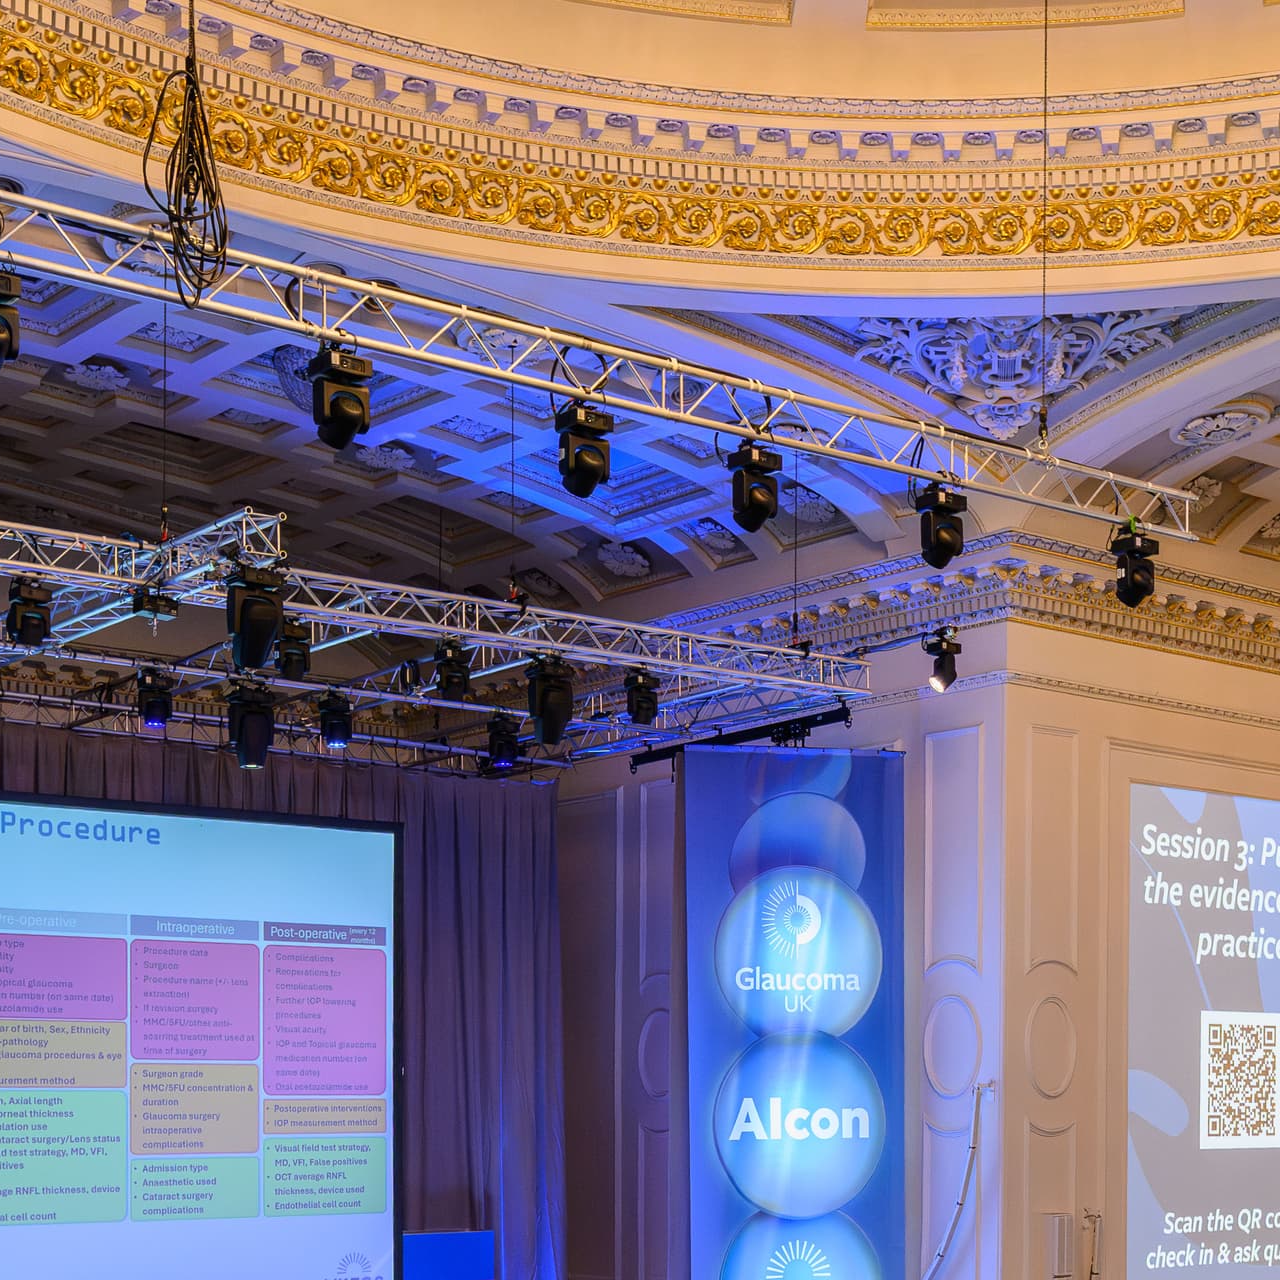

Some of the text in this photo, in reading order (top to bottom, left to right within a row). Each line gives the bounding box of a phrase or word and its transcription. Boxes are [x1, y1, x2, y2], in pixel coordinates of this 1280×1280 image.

[1, 811, 162, 845] Procedure
[1141, 824, 1229, 862] Session
[1234, 840, 1255, 871] 3:
[1144, 872, 1183, 905] the
[157, 919, 235, 936] Intraoperative
[270, 926, 347, 941] Post-operative
[735, 967, 860, 992] Glaucoma
[784, 995, 812, 1013] UK
[729, 1096, 870, 1141] Alcon
[1164, 1212, 1203, 1234] Scan
[1207, 1209, 1233, 1231] the
[1238, 1208, 1262, 1233] QR
[1146, 1244, 1194, 1269] check
[1199, 1243, 1213, 1265] in
[1217, 1242, 1230, 1264] &
[1234, 1240, 1260, 1263] ask
